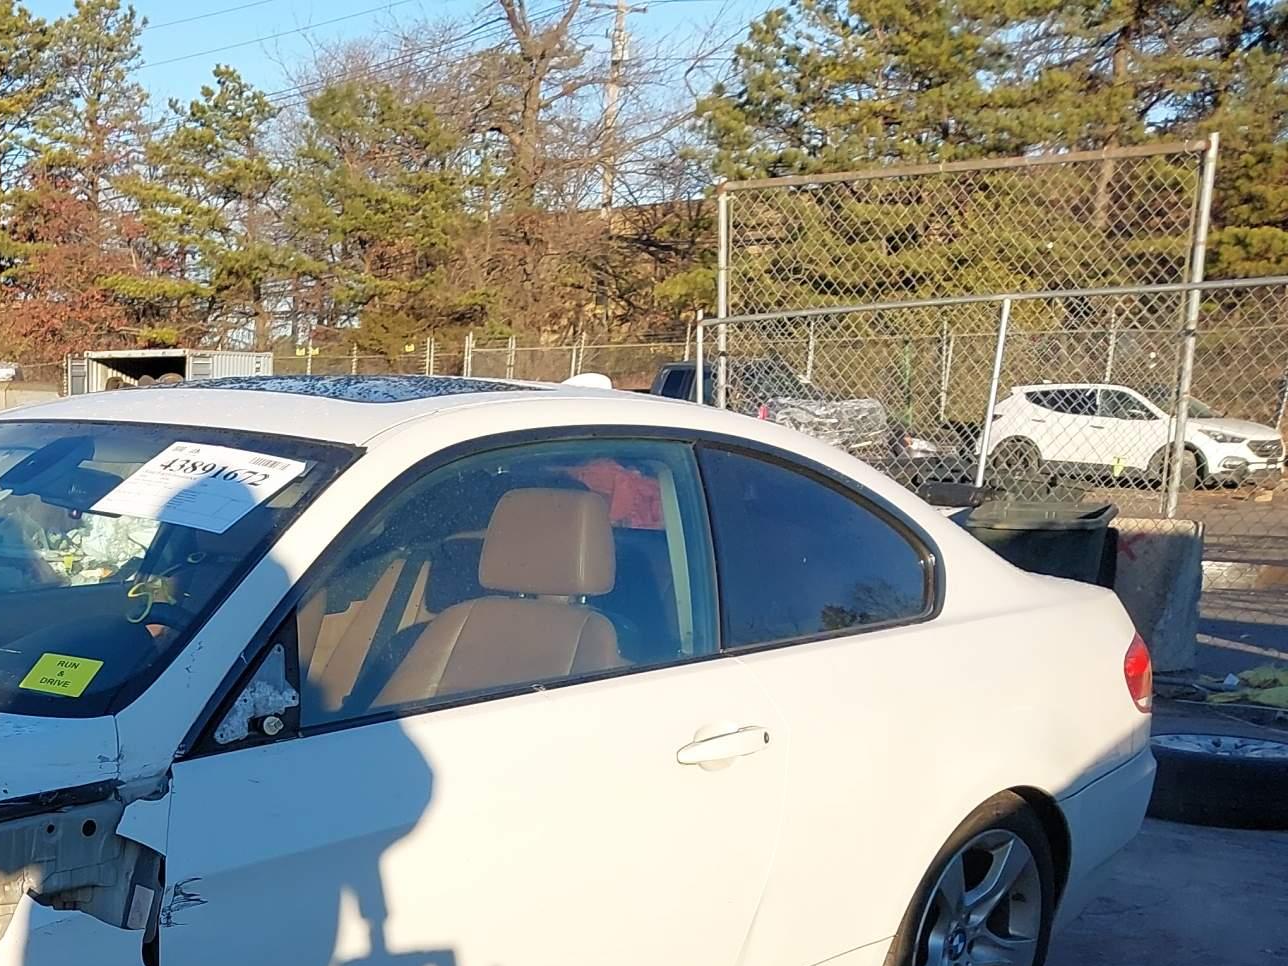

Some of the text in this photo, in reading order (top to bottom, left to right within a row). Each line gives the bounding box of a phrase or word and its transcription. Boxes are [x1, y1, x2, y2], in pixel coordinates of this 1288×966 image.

[160, 458, 270, 486] 43891672
[57, 660, 80, 669] RUN
[39, 677, 71, 688] DRIVE
